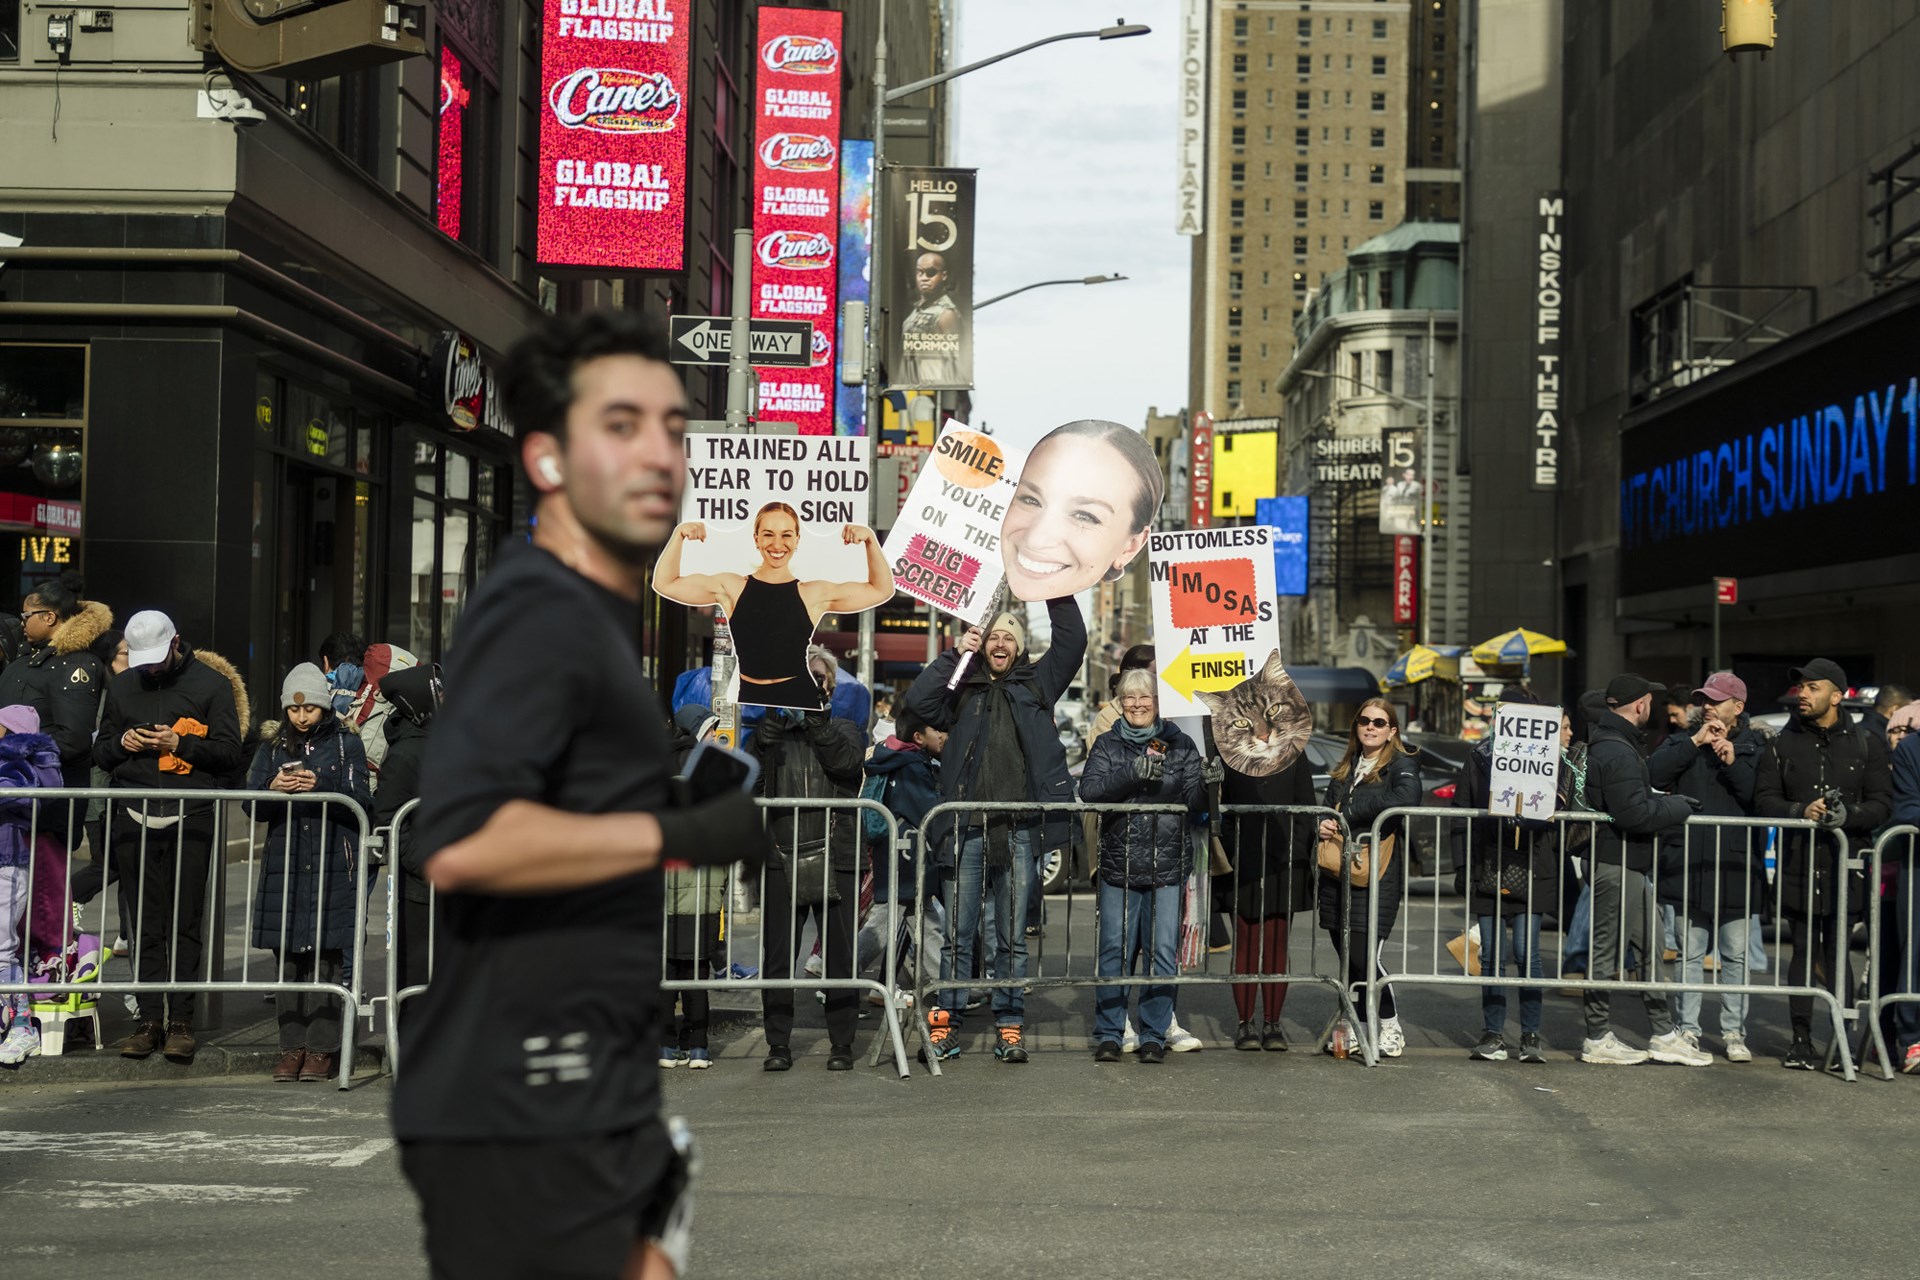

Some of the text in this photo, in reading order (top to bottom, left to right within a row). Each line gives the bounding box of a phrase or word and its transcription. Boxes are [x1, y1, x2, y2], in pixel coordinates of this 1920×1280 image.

[560, 0, 674, 22] GLOBAL
[559, 17, 674, 43] FLAGSHIP
[765, 35, 835, 69] Cane's
[557, 68, 678, 125] Cane's
[765, 88, 832, 106] GLOBAL
[764, 103, 832, 119] FLAGSHIP
[763, 132, 833, 167] Cane's
[556, 159, 670, 190] GLOBAL
[910, 179, 958, 193] HELLO
[1180, 128, 1199, 231] PLAZA
[554, 186, 670, 212] FLAGSHIP
[763, 186, 829, 204] GLOBAL
[762, 201, 830, 217] FLAGSHIP
[905, 192, 958, 252] 15
[761, 230, 831, 265] Cane's
[761, 284, 827, 302] GLOBAL
[760, 299, 827, 315] FLAGSHIP
[692, 331, 731, 350] ONE
[751, 333, 793, 352] WAY
[903, 332, 960, 341] THE BOOK OF
[903, 340, 960, 351] MORMON
[1535, 198, 1563, 484] MINSKOFF THEATRE
[759, 382, 825, 400] GLOBAL
[758, 398, 825, 413] FLAGSHIP
[685, 437, 691, 458] I
[706, 438, 808, 461] TRAINED
[816, 440, 860, 462] ALL
[1316, 438, 1383, 456] SHUBER
[1386, 438, 1415, 468] 15
[1649, 435, 1753, 543] CHURCH
[1759, 384, 1896, 518] SUNDAY
[1901, 376, 1920, 485] 1
[689, 467, 869, 492] YEAR TO HOLD
[1316, 463, 1383, 481] THEATR
[697, 497, 853, 523] THIS SIGN
[942, 480, 1005, 522] YOU'RE
[37, 503, 66, 527] GLOBAL
[921, 505, 1000, 552] ON THE
[1150, 528, 1268, 552] BOTTOMLESS
[921, 539, 963, 574] BIG
[891, 557, 976, 609] SCREEN
[1150, 560, 1273, 622] MIMOSAS
[1398, 555, 1412, 606] PARK
[1189, 625, 1255, 645] AT THE
[1499, 716, 1559, 740] KEEP
[1495, 756, 1554, 777] GOING
